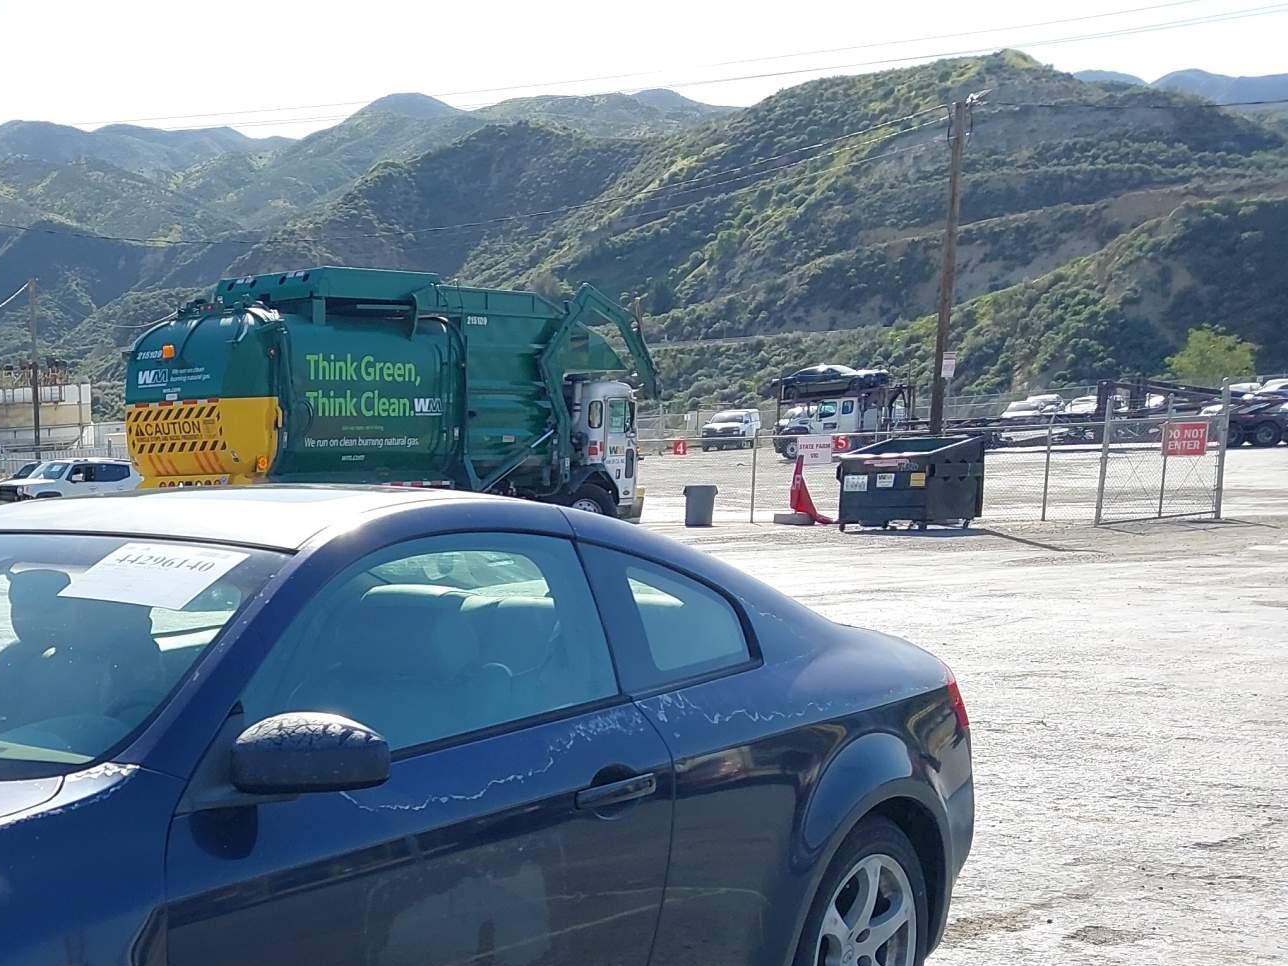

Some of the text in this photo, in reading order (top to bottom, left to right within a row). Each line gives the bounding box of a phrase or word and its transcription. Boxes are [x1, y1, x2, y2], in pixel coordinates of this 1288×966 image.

[138, 368, 169, 385] WM
[305, 353, 421, 387] Think Green,
[305, 390, 414, 417] Think Clean.
[414, 397, 442, 412] WM
[145, 421, 201, 437] CAUTION
[1184, 429, 1206, 439] NOT
[304, 437, 316, 448] We
[316, 439, 328, 447] run
[329, 439, 339, 447] on
[339, 436, 357, 447] clean
[358, 436, 384, 448] burning
[384, 436, 407, 446] natural
[676, 443, 684, 454] 4
[837, 435, 847, 449] 5
[1168, 440, 1201, 450] ENTER
[115, 553, 216, 572] 44296140
